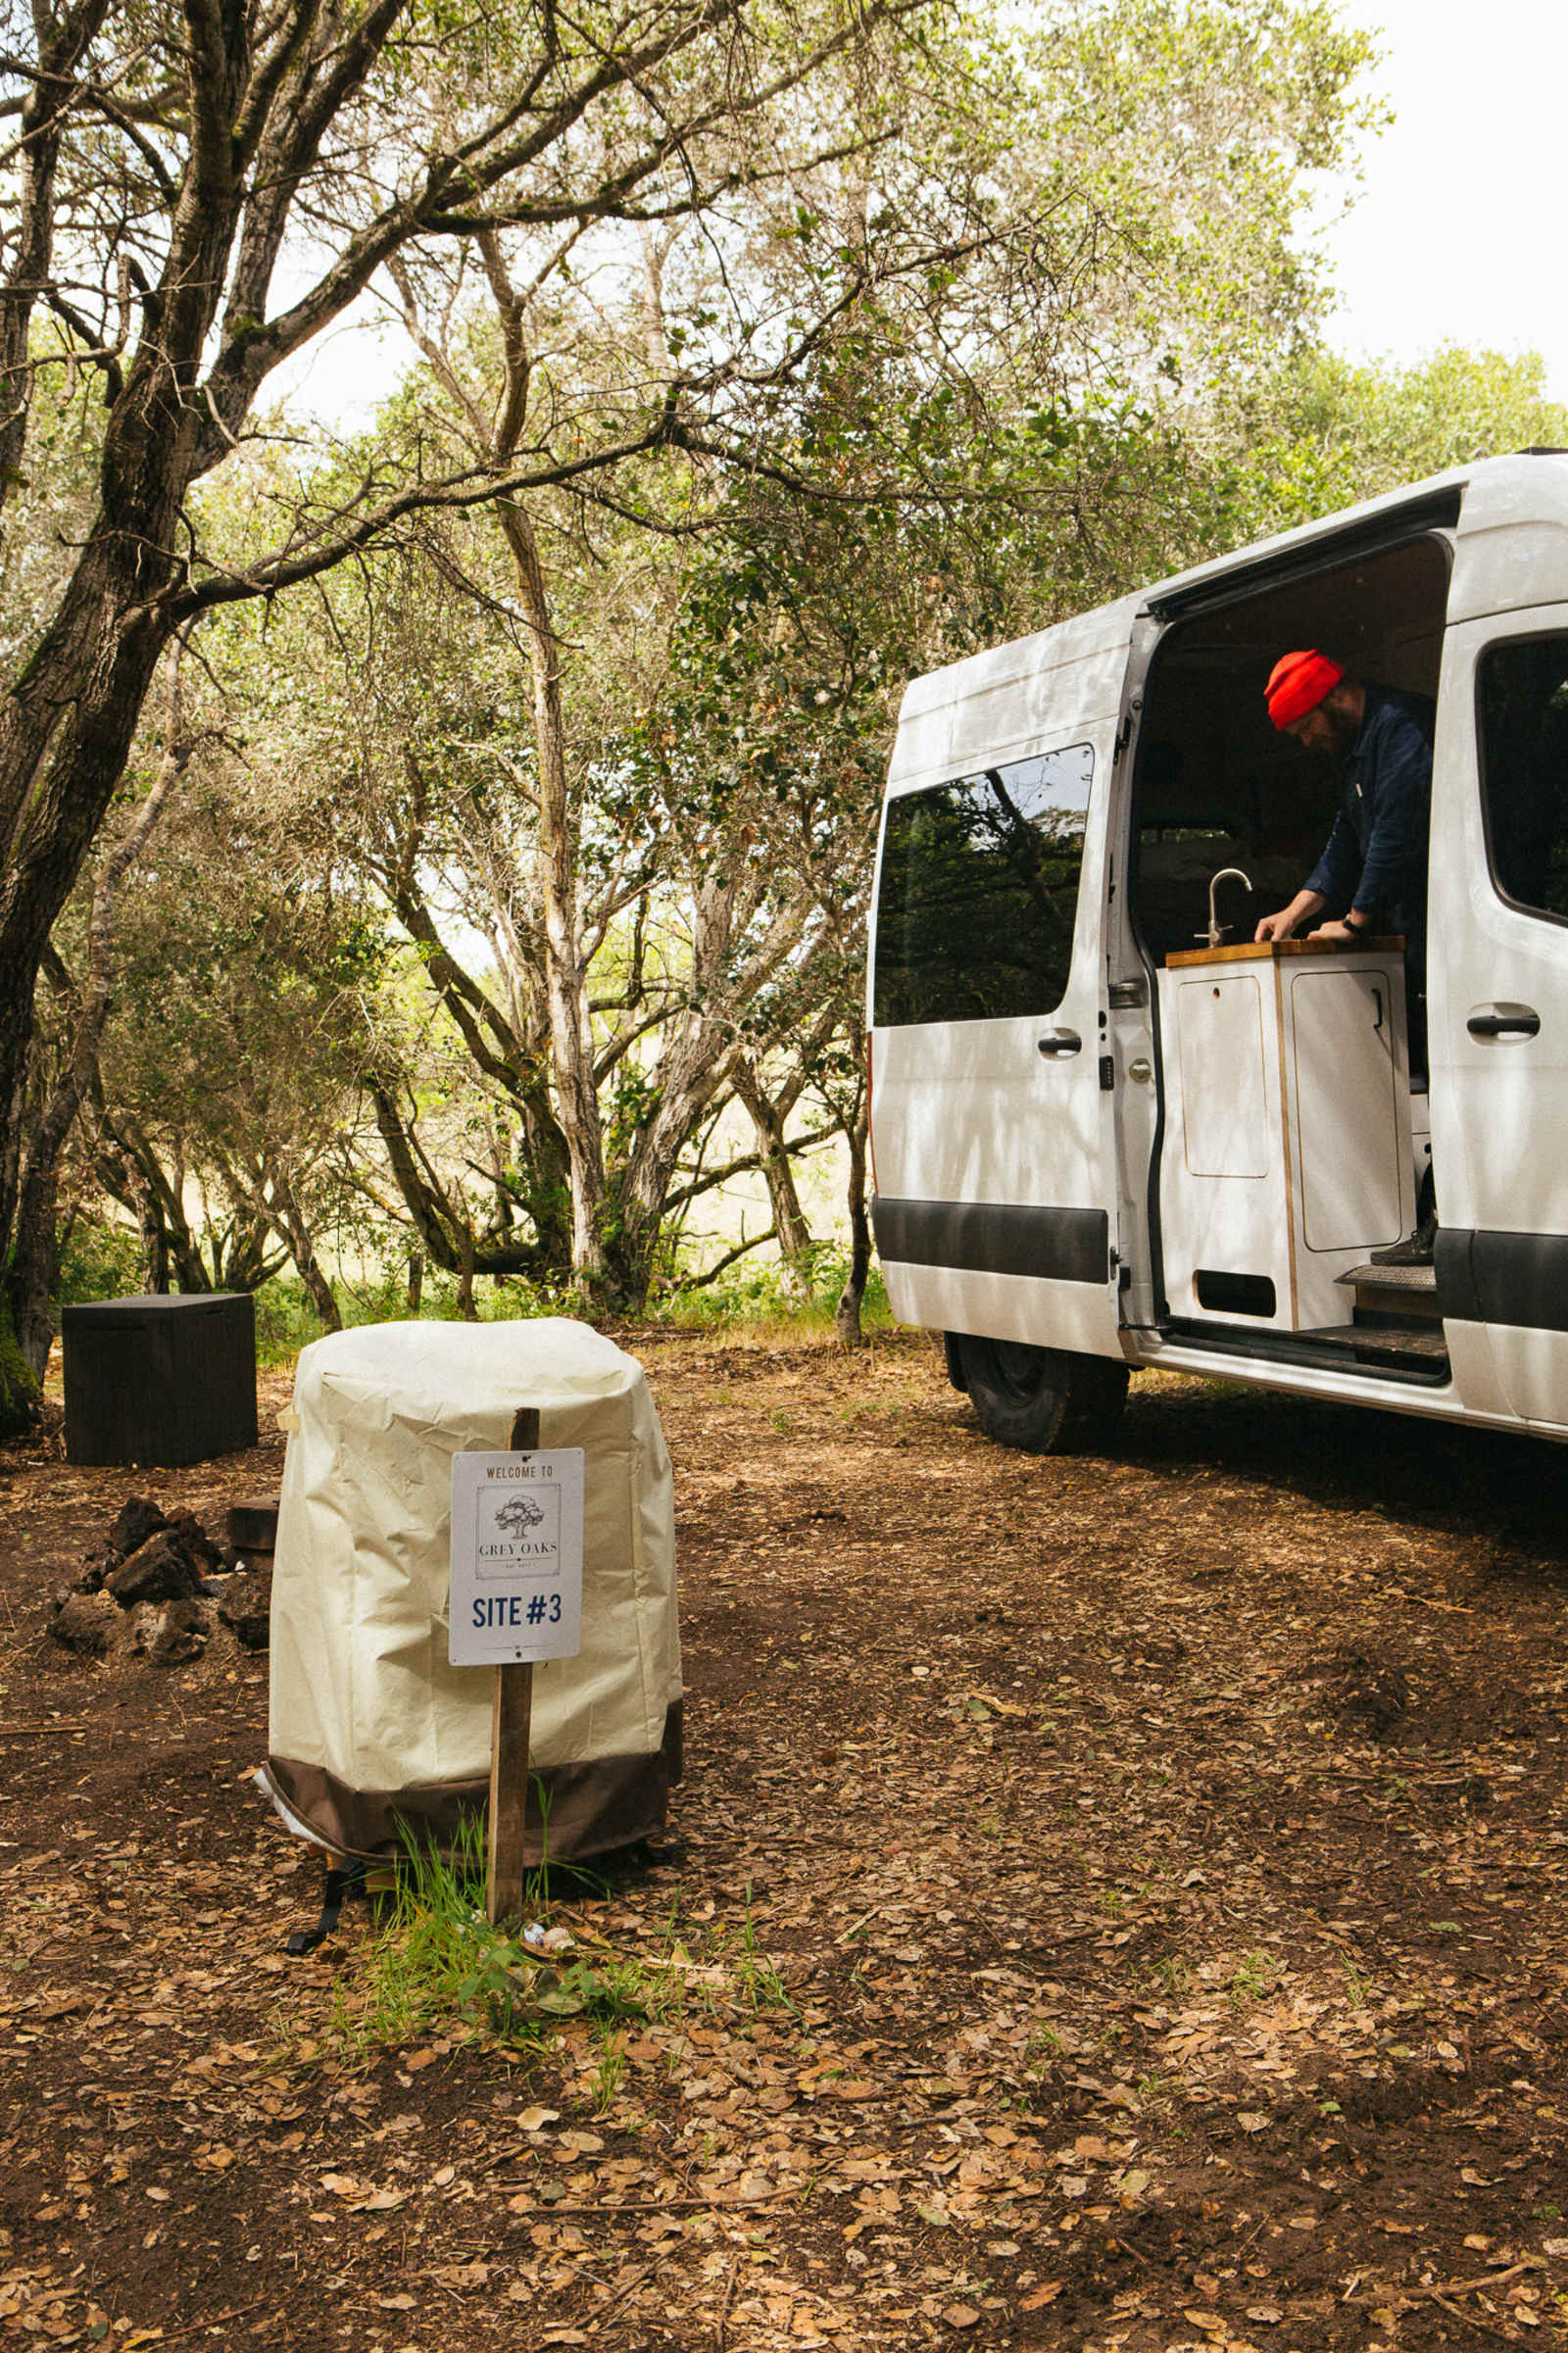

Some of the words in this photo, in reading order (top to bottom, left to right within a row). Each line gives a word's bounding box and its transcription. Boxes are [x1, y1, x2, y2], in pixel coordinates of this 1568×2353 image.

[486, 1466, 536, 1479] WELCOME
[541, 1465, 553, 1478] TO
[479, 1544, 515, 1556] GREY
[520, 1542, 558, 1554] OAKS
